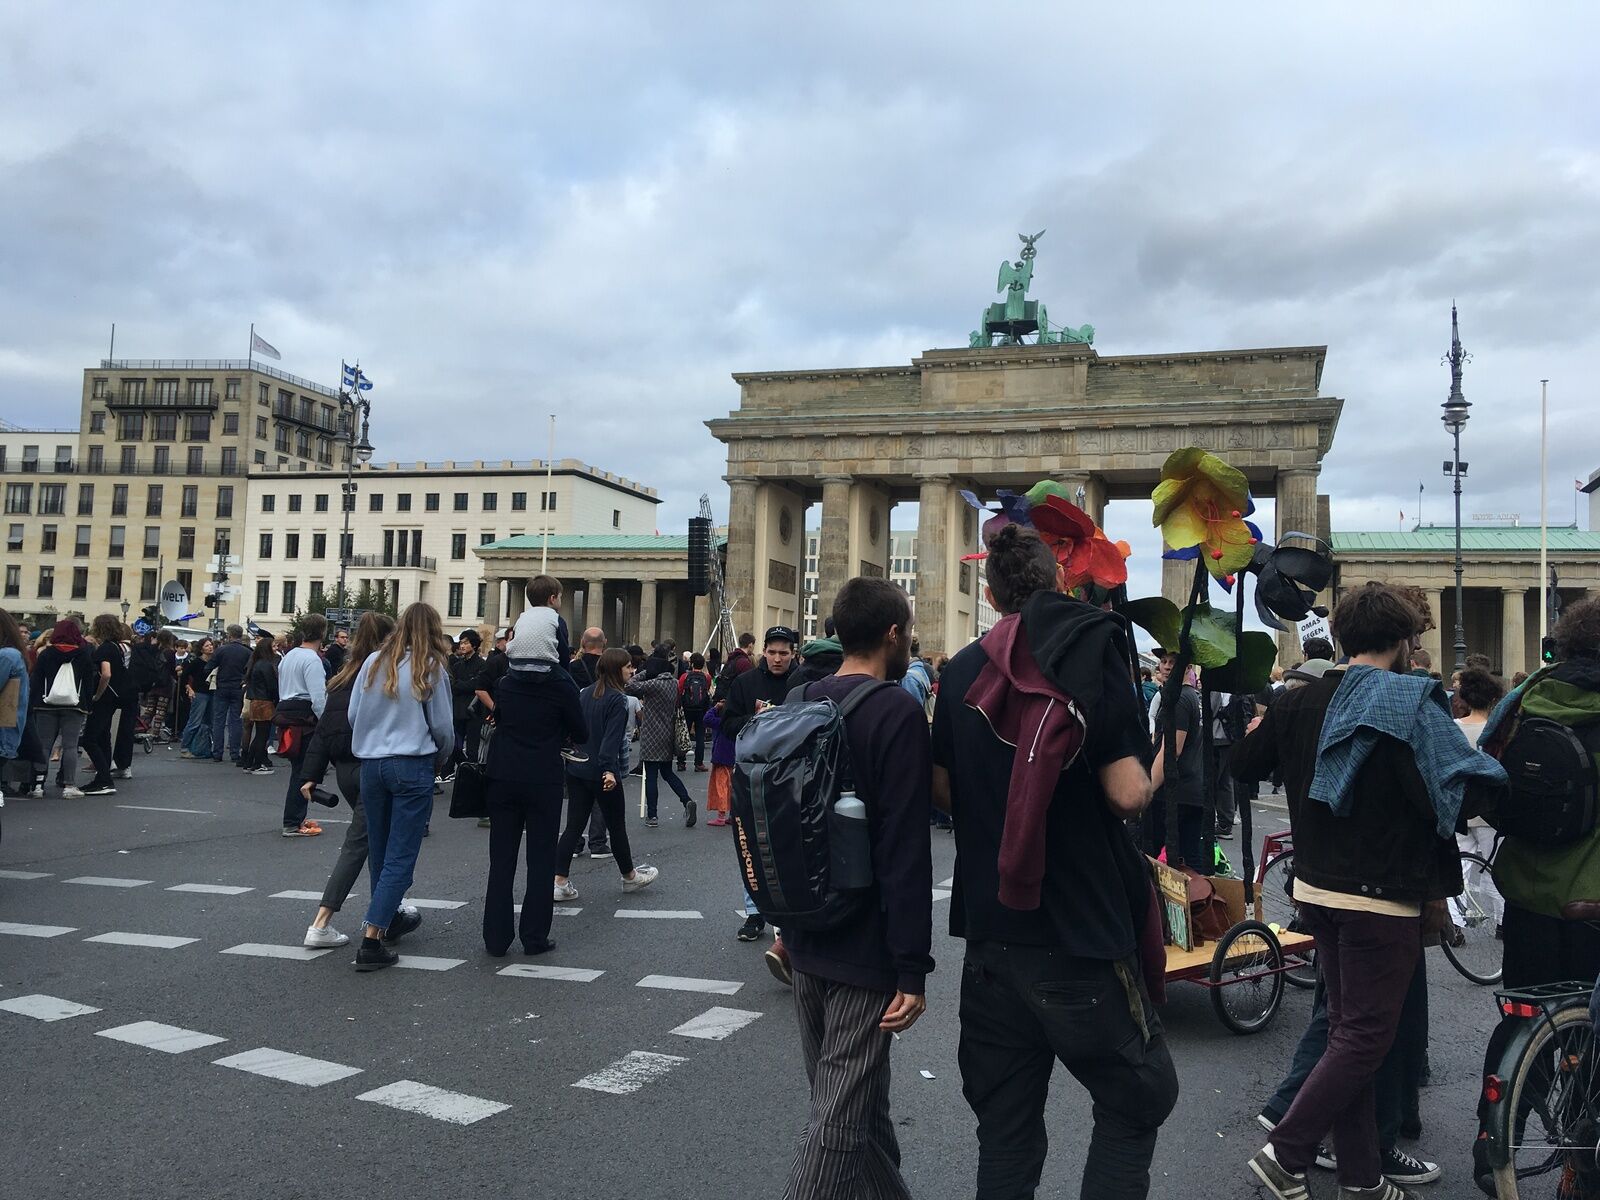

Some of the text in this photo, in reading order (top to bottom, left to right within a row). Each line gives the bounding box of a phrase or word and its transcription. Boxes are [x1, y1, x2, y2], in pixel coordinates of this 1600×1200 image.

[1301, 617, 1321, 632] OMAS
[1302, 626, 1324, 642] GEGEN
[735, 816, 759, 891] patagonia
